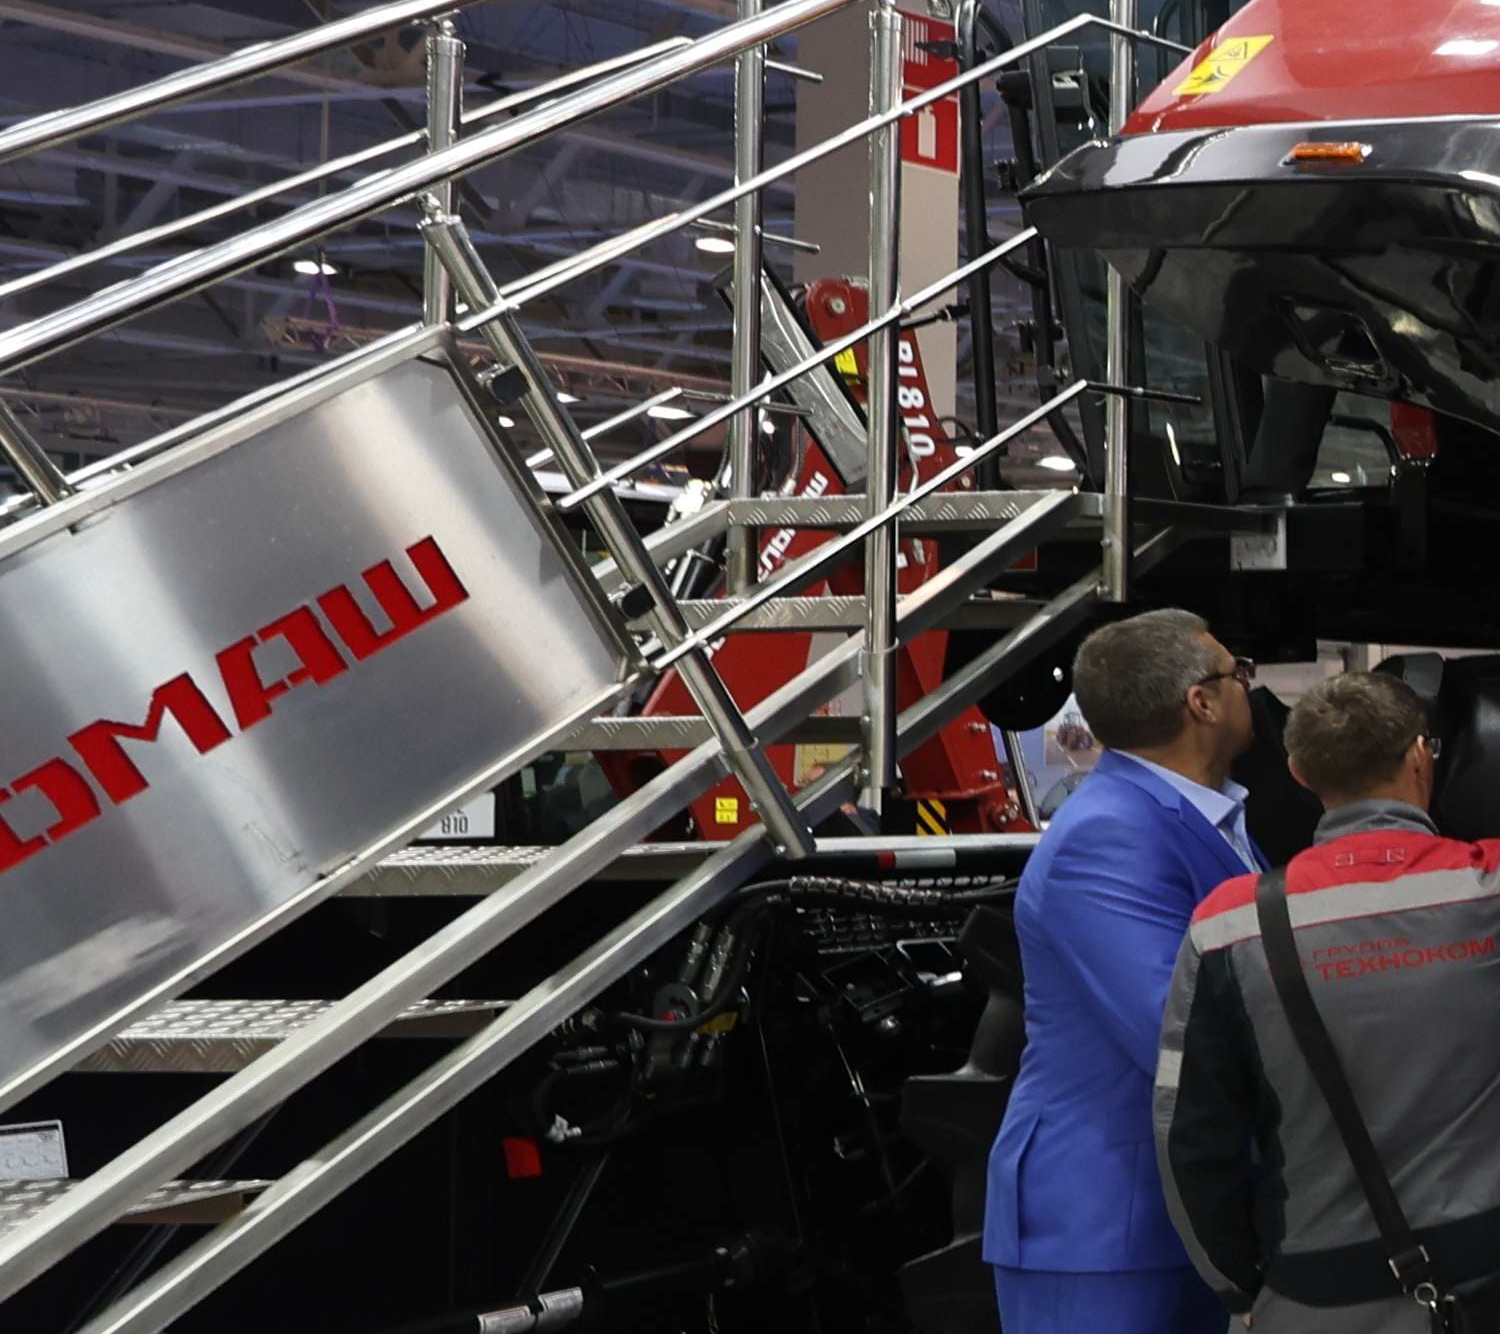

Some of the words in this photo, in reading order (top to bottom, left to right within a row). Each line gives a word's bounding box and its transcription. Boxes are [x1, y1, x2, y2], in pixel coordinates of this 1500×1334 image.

[899, 387, 936, 457] 810
[1312, 938, 1410, 958] ГРУППА
[1317, 937, 1496, 981] ТЕХНОКОМ
